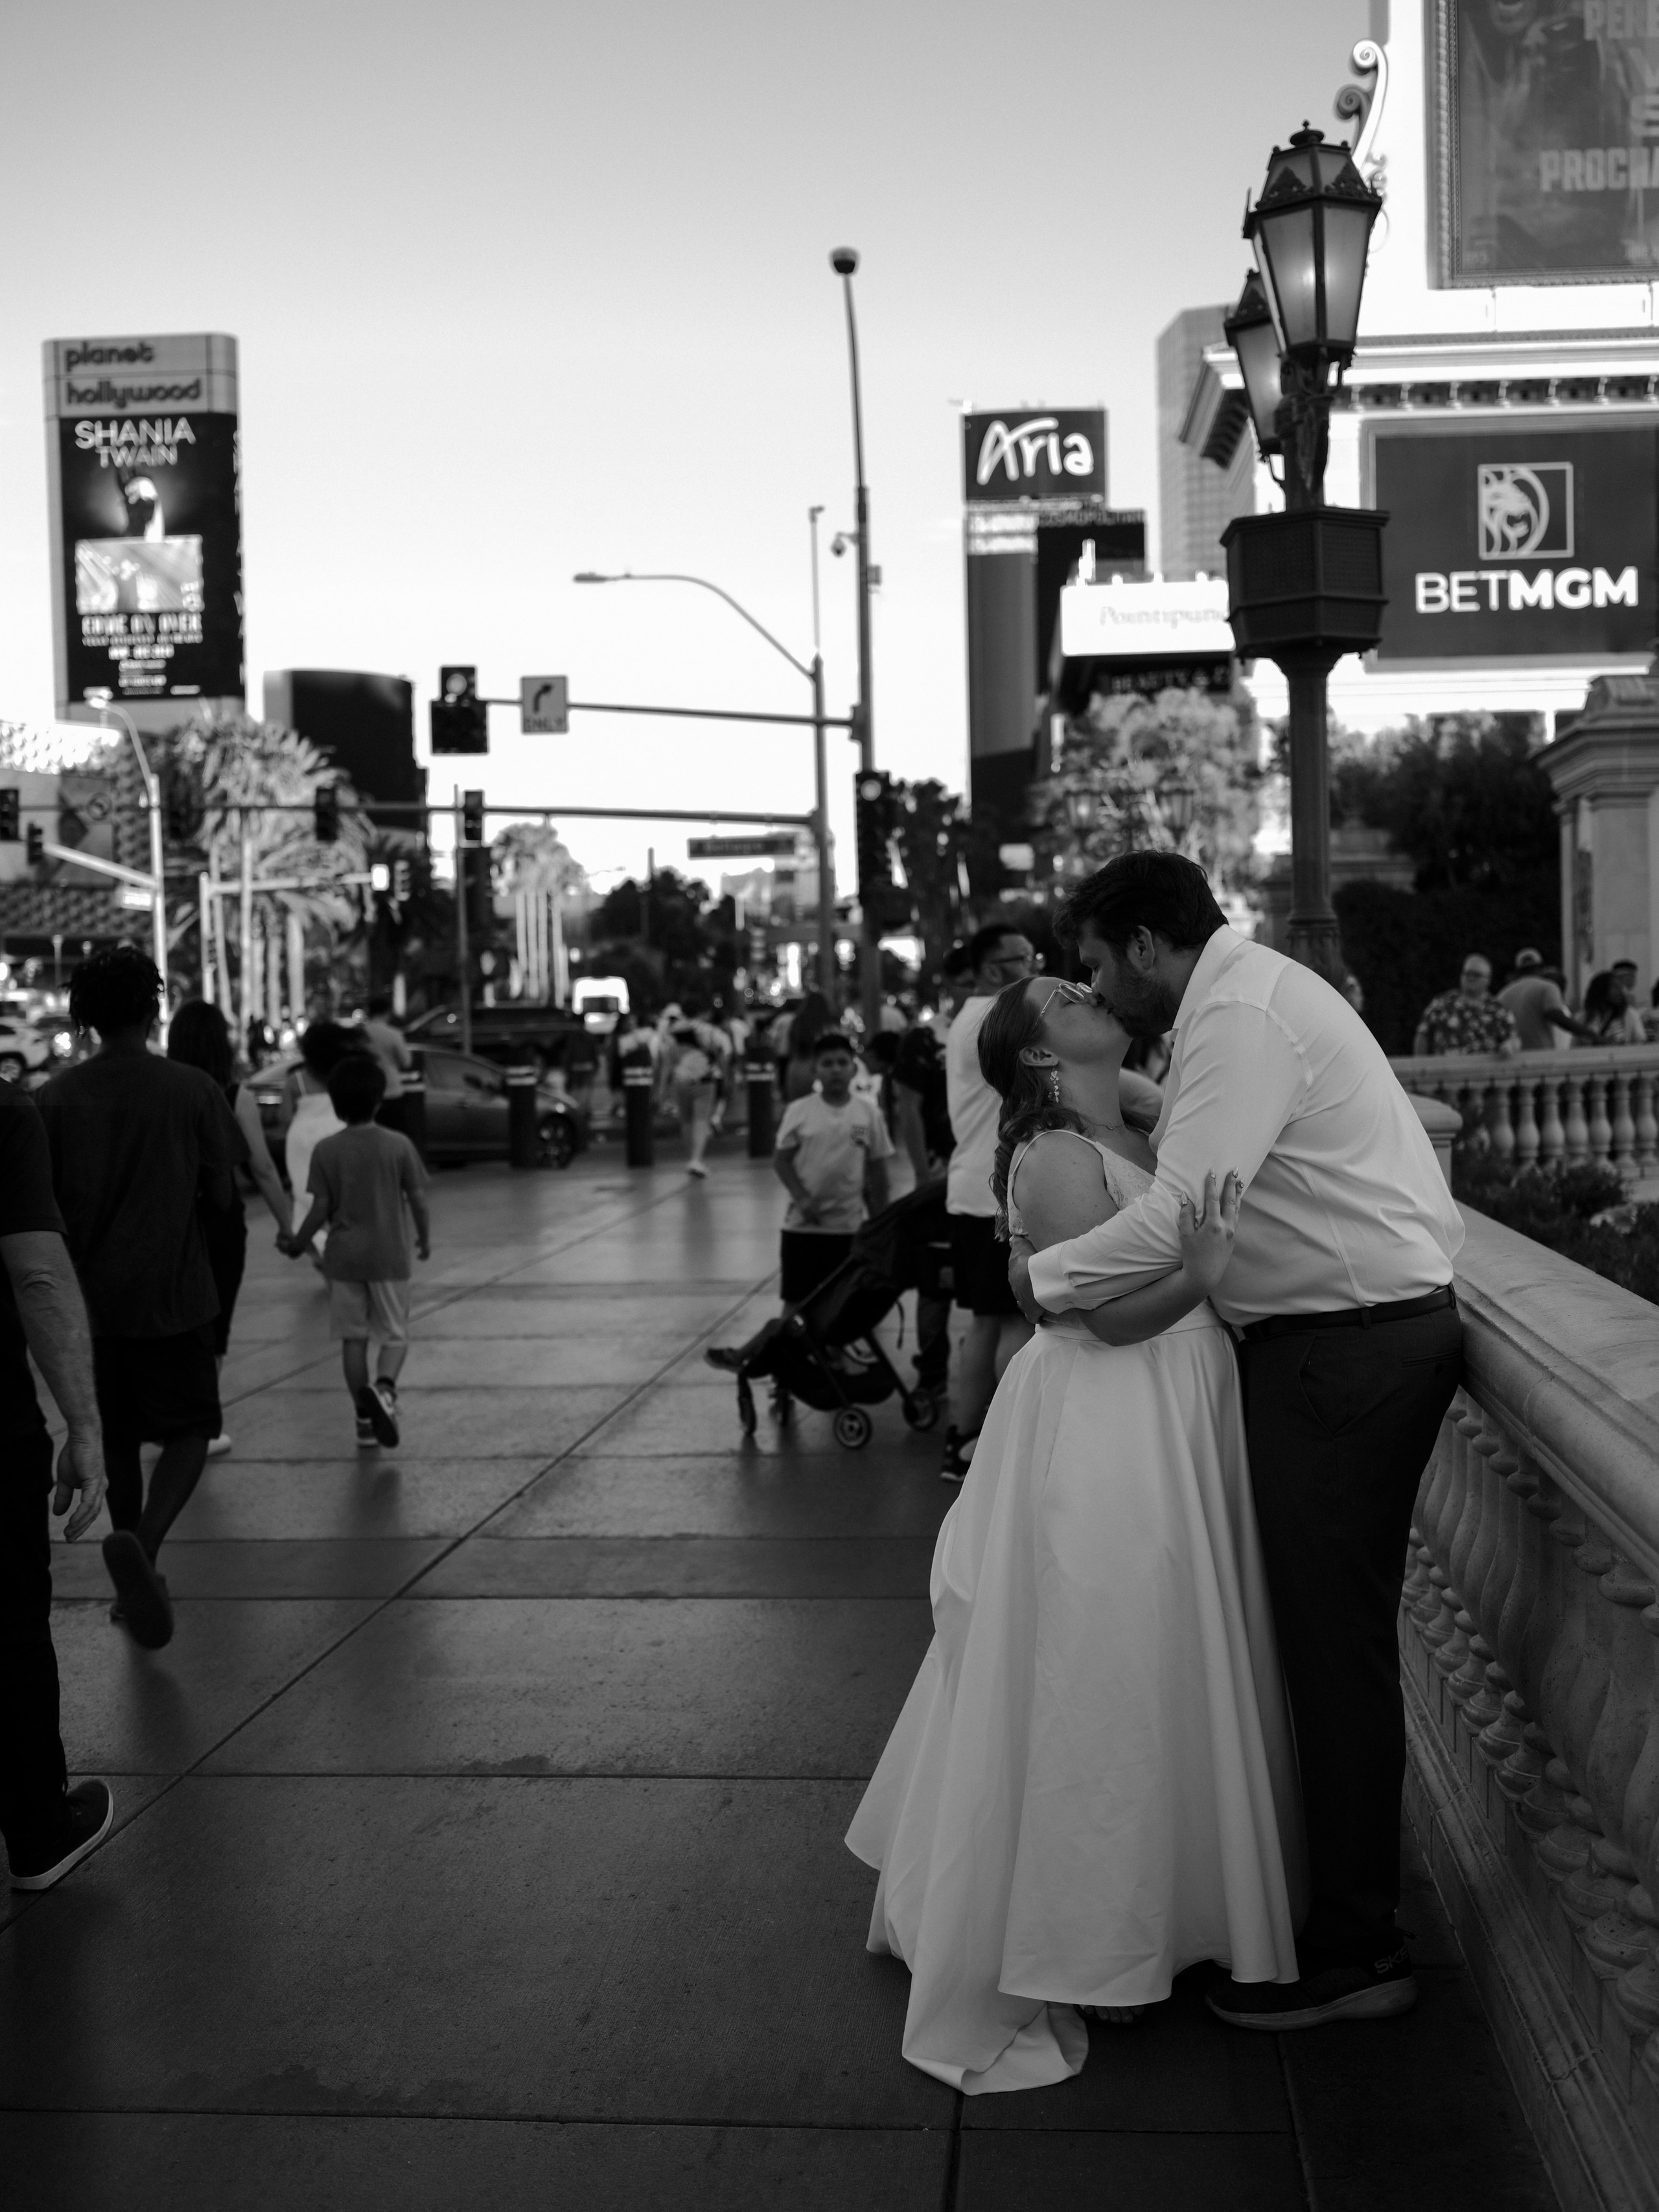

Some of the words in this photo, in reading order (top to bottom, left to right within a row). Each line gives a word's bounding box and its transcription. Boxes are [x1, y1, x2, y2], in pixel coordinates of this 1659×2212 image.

[65, 341, 154, 372] planet
[67, 377, 201, 408] hollywood
[75, 417, 196, 450] SHANIA
[95, 443, 178, 468] TWAIN
[977, 417, 1094, 485] Aria
[1415, 566, 1639, 613] BETMGM
